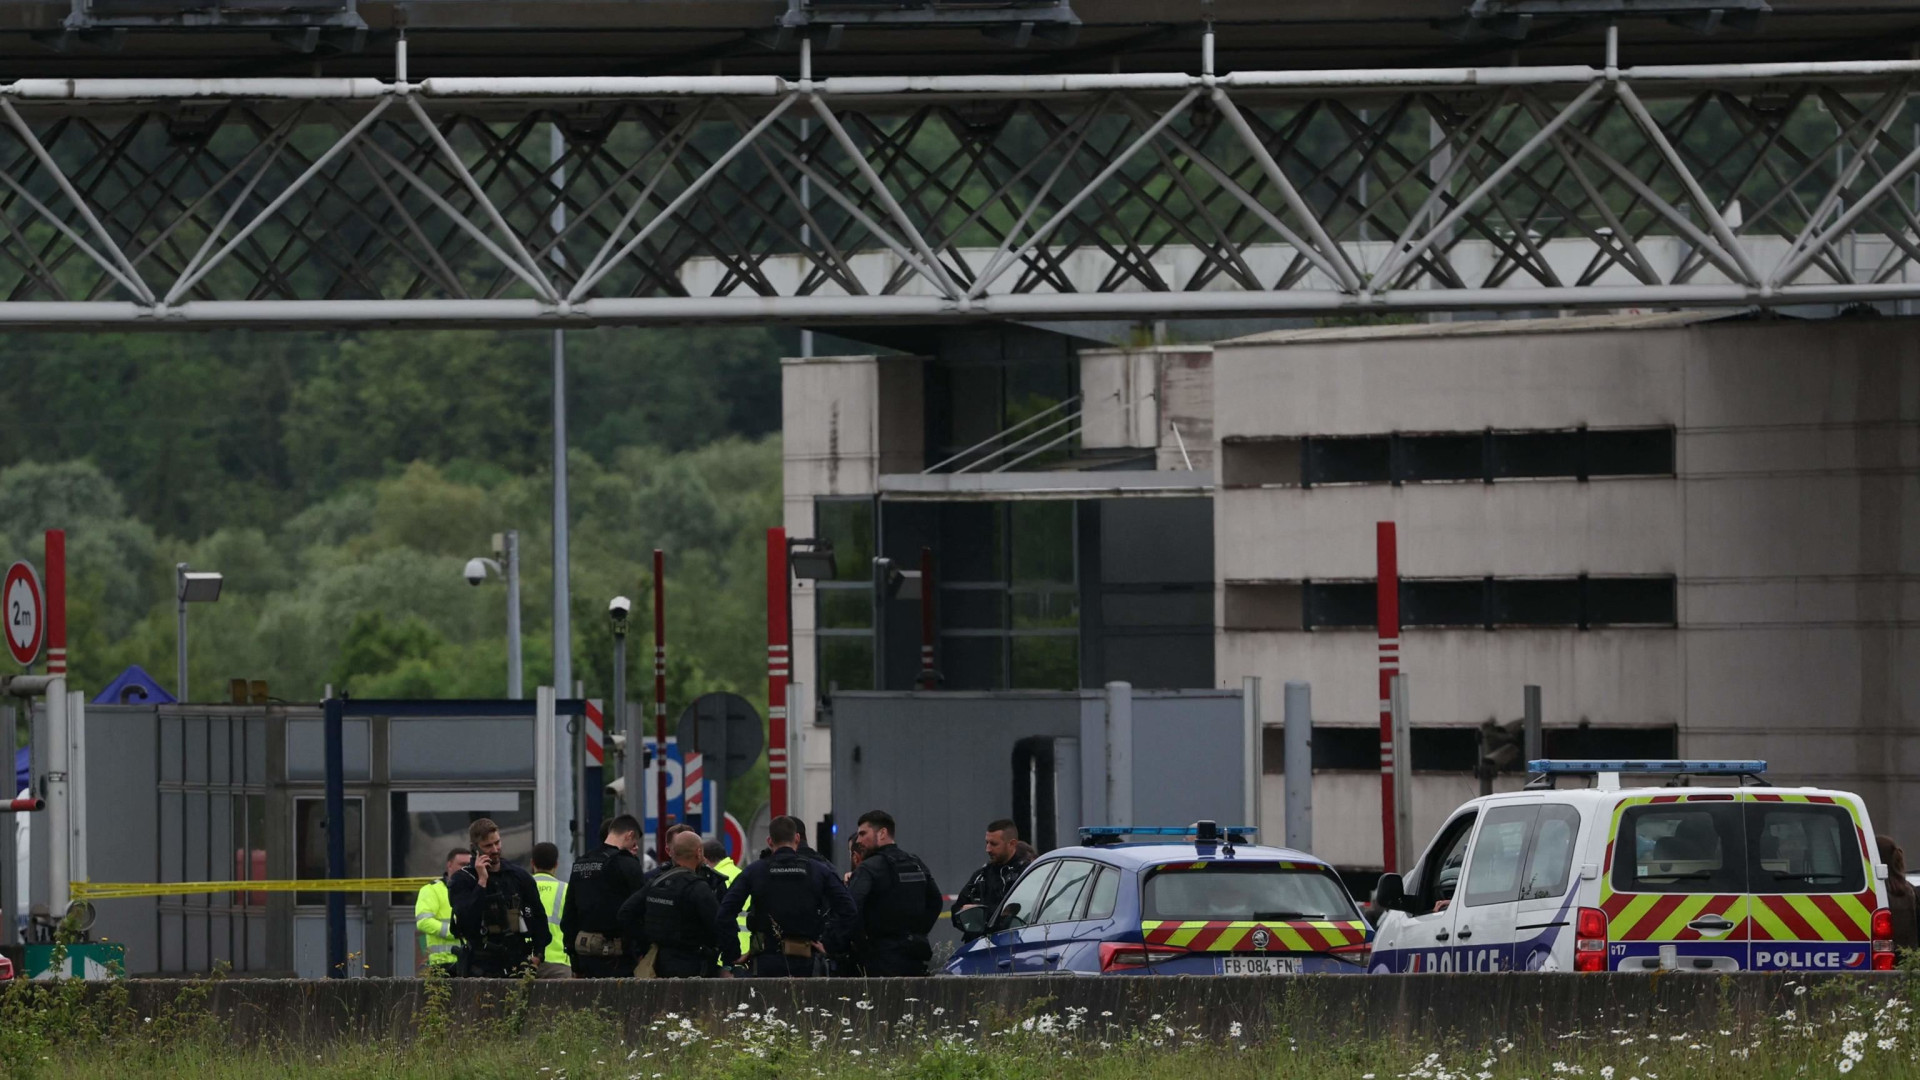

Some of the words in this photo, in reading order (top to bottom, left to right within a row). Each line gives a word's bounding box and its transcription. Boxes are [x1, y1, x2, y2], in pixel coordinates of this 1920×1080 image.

[645, 758, 684, 818] P
[1224, 959, 1293, 974] FB-084-FN
[1756, 951, 1840, 967] POLICE
